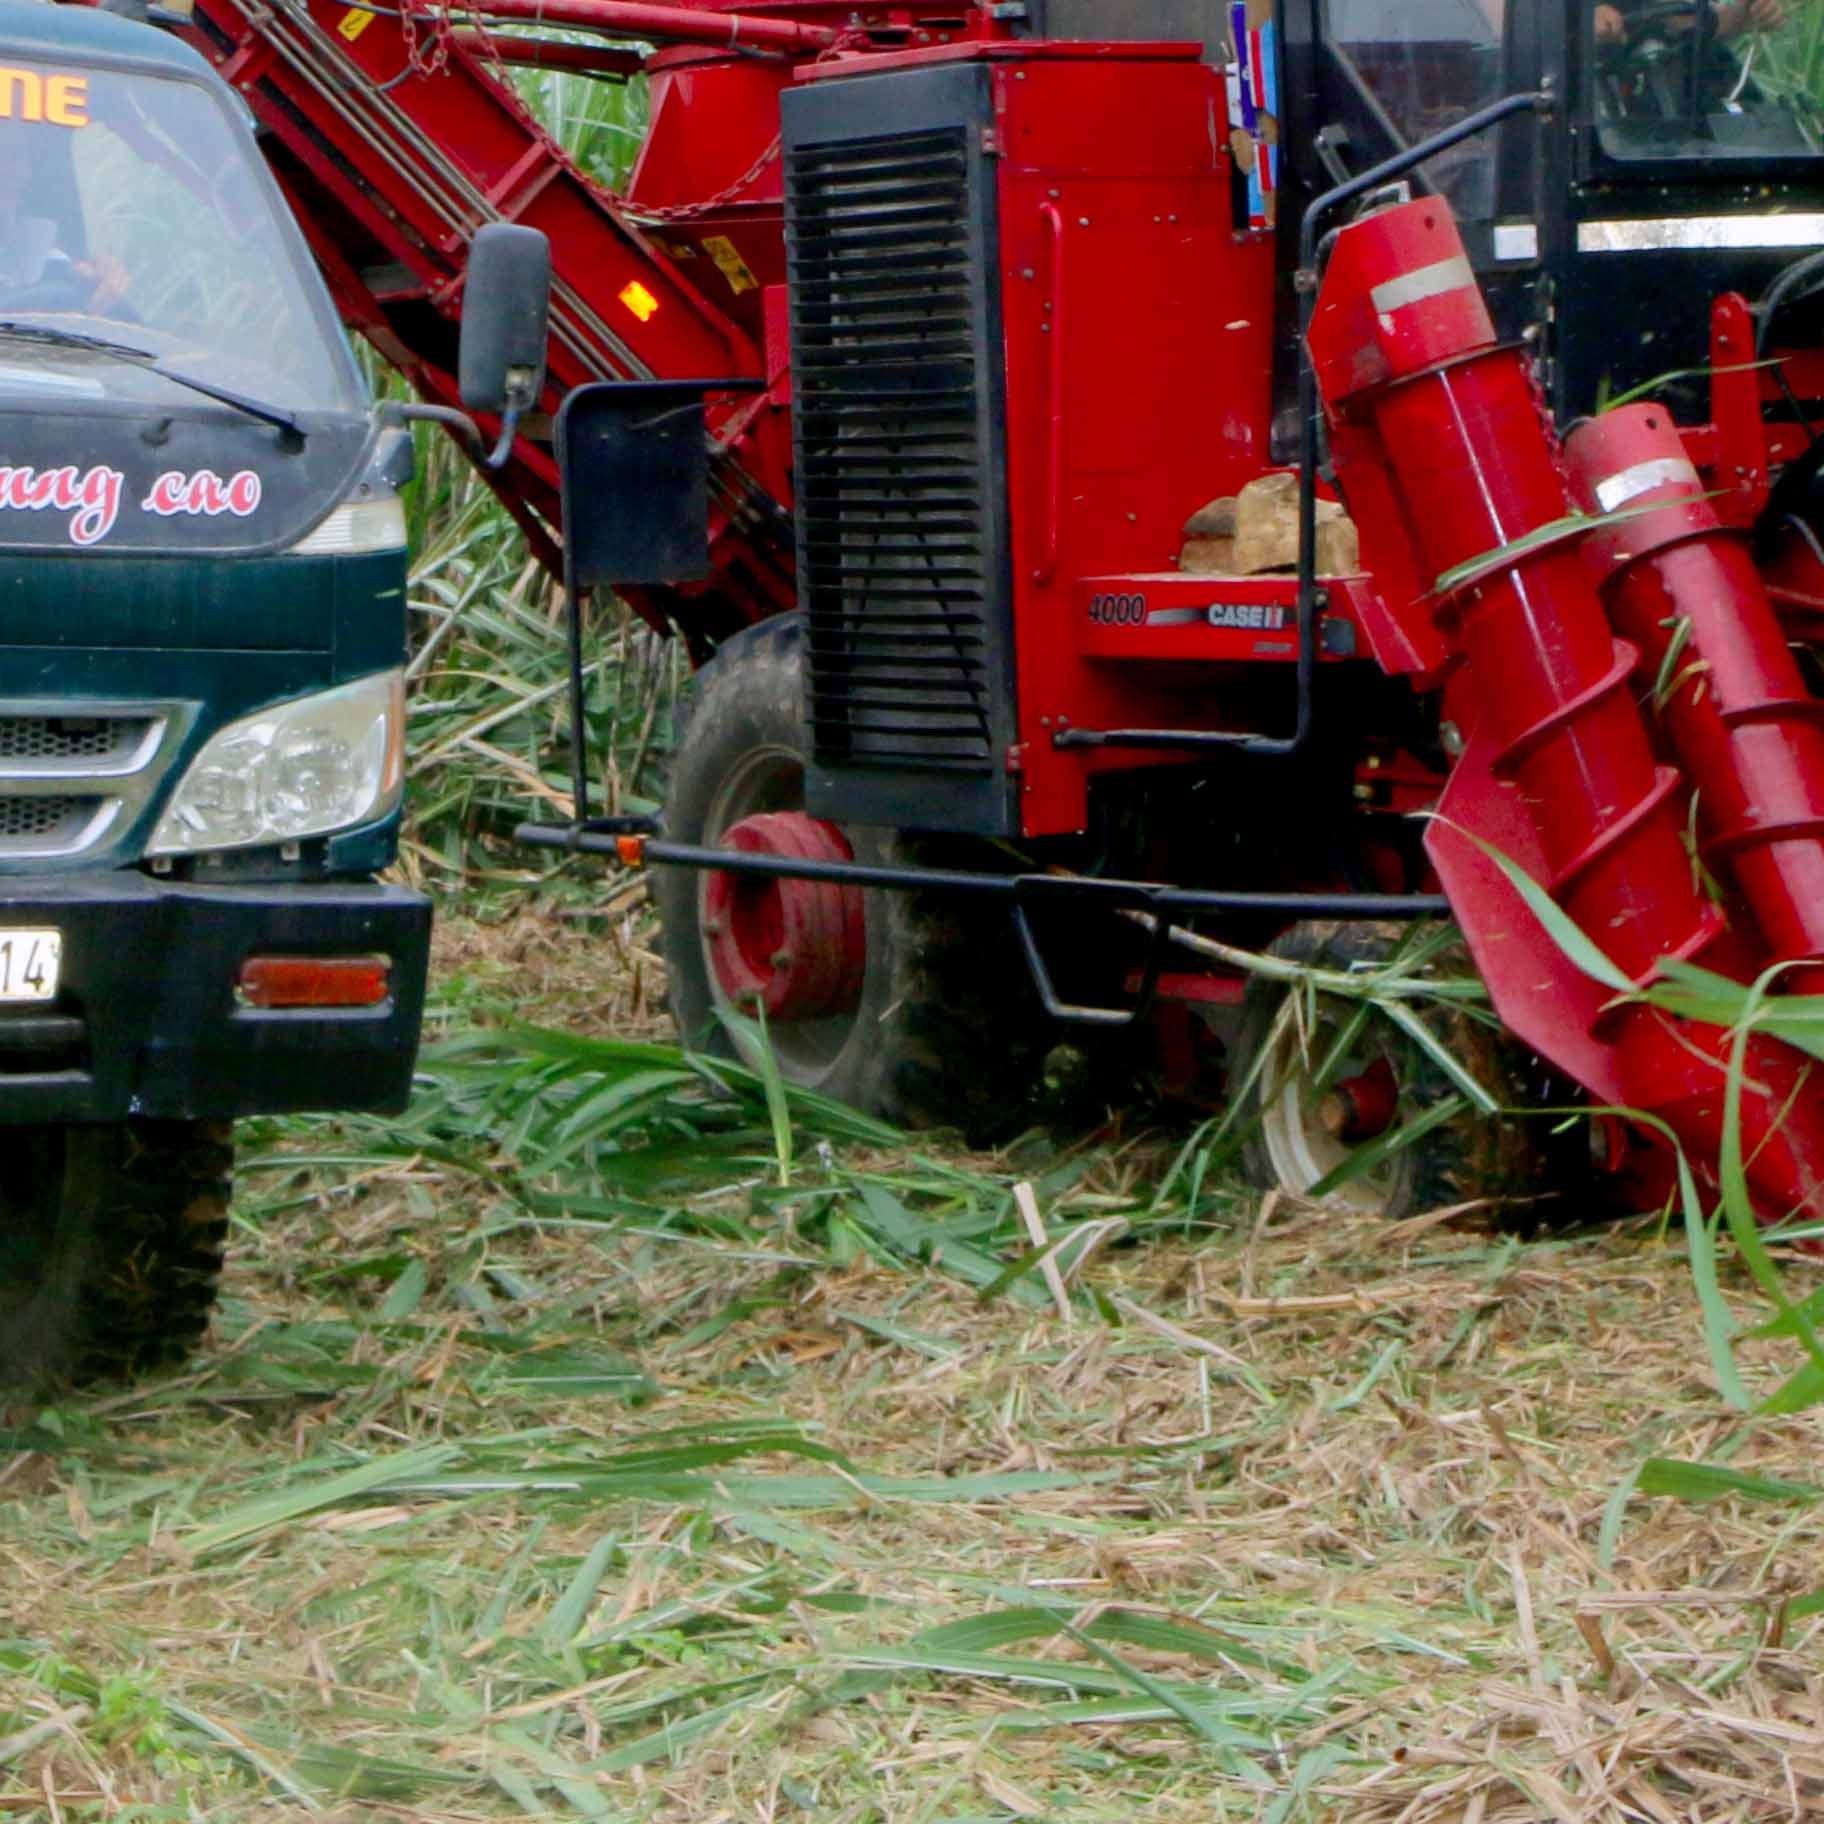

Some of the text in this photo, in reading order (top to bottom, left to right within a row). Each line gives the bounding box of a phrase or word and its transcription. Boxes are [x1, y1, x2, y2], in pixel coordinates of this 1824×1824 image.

[141, 469, 262, 516] cao
[1088, 593, 1146, 625] 4000
[1208, 603, 1263, 628] CASE
